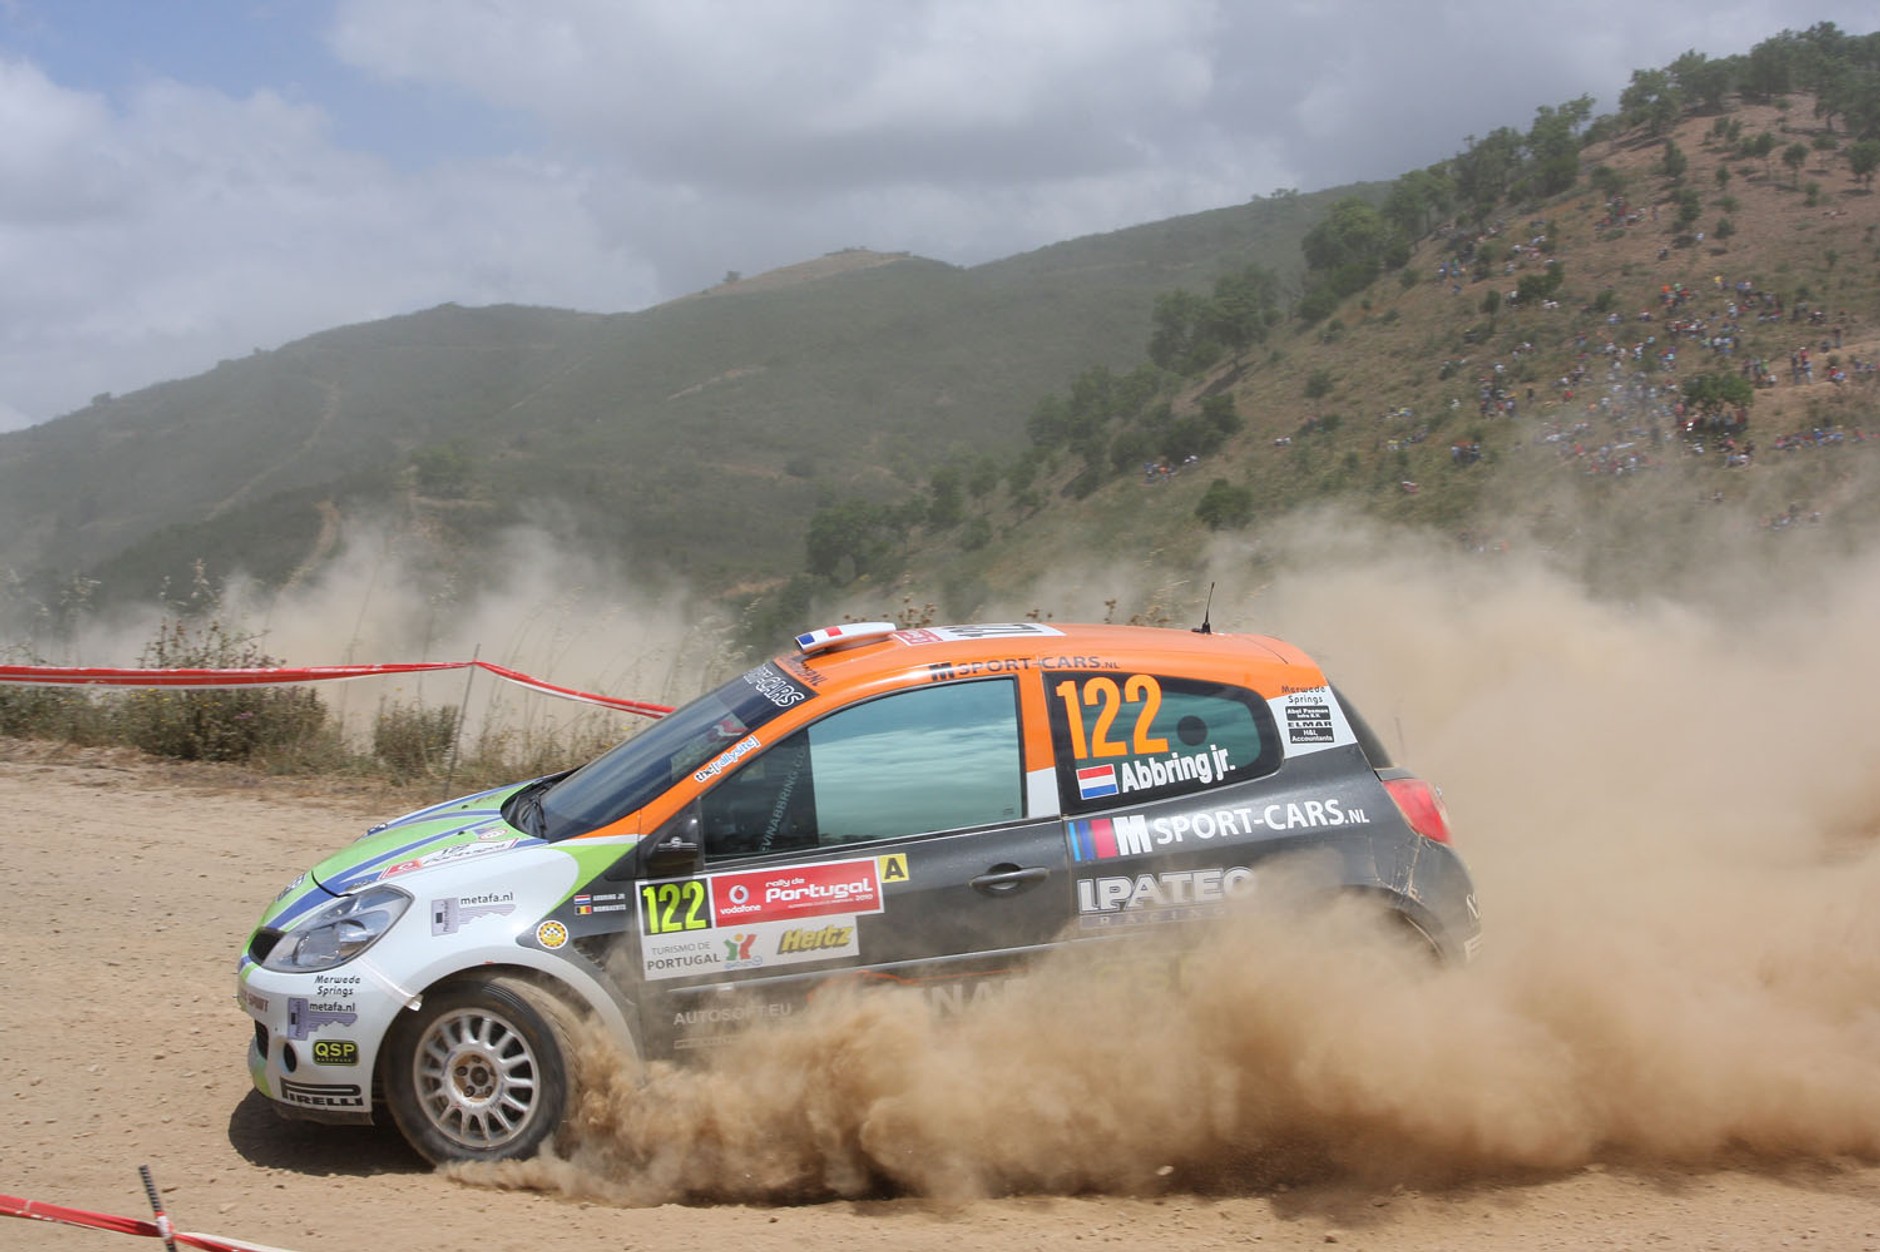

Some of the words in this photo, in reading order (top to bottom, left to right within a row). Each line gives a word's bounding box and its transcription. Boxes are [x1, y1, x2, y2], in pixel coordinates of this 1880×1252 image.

[1281, 685, 1326, 694] Merwede
[1288, 695, 1324, 705] Springs
[1056, 674, 1170, 760] 122
[1120, 754, 1212, 794] Abbring
[1210, 744, 1236, 782] jr.
[1154, 799, 1370, 846] SPORT-CARS.NL
[884, 857, 906, 880] A
[765, 878, 791, 888] rally
[791, 877, 805, 886] de
[765, 877, 874, 904] Portugal
[460, 892, 514, 905] metafa.nl
[642, 880, 707, 934] 122
[720, 904, 762, 915] vodafone
[776, 924, 854, 955] Hertz
[652, 942, 697, 955] TURISMO
[698, 942, 712, 951] DE
[647, 953, 722, 971] PORTUGAL
[314, 975, 361, 985] Merwede
[316, 985, 355, 997] Springs
[309, 1002, 356, 1013] metafa.nl
[315, 1042, 356, 1057] QSP
[280, 1076, 364, 1107] PIRELLI
